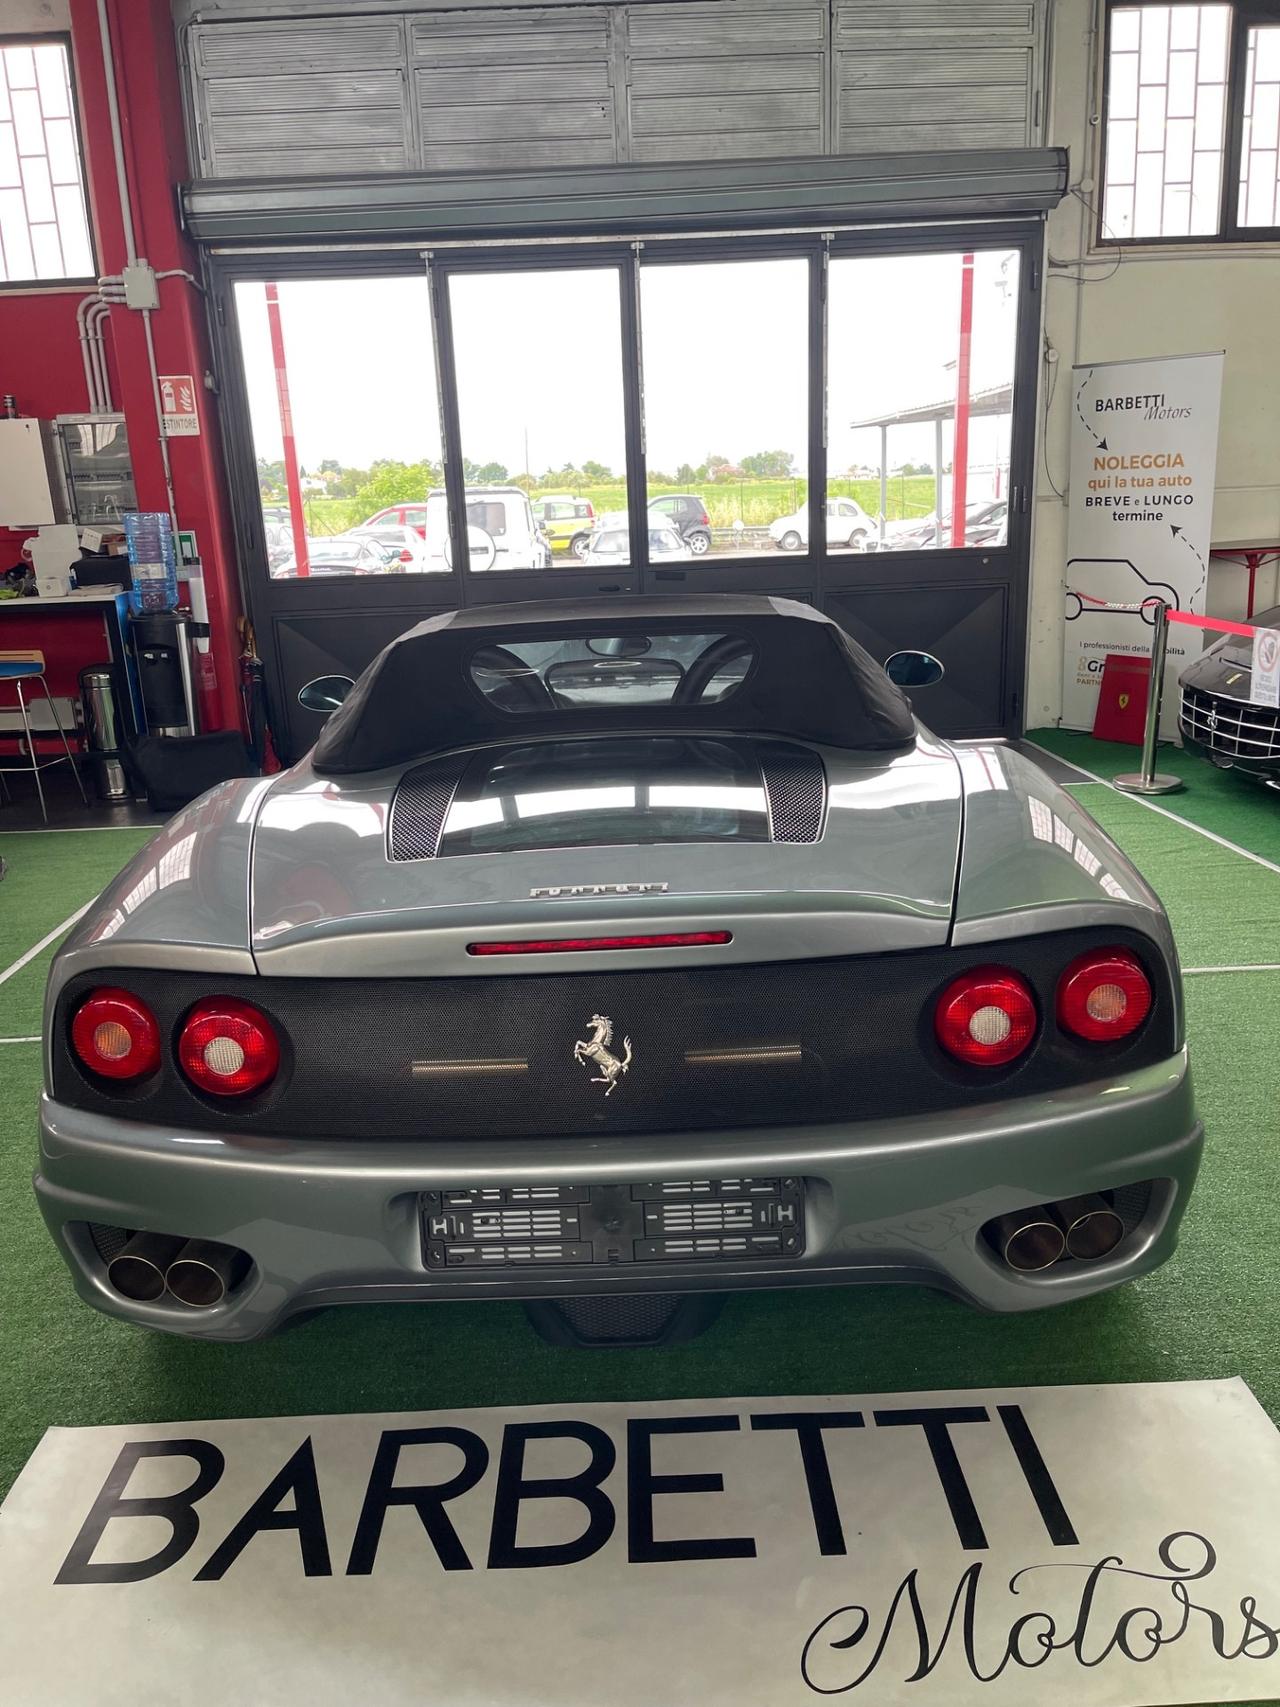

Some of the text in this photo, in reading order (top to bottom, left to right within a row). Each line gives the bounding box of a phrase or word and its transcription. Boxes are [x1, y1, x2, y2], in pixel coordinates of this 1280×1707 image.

[1095, 394, 1165, 412] BARBETTI
[1144, 405, 1192, 420] Motors
[1094, 453, 1185, 471] NOLEGGIA
[1088, 475, 1192, 491] qui la tua auto
[1085, 496, 1131, 507] BREVE
[1144, 494, 1194, 506] LUNGO
[1112, 509, 1163, 521] termine
[1083, 641, 1131, 651] professionisti
[1131, 645, 1150, 653] della
[1076, 677, 1101, 687] PARTN
[52, 1404, 1082, 1585] BARBETTI
[801, 1531, 1280, 1695] Motors
